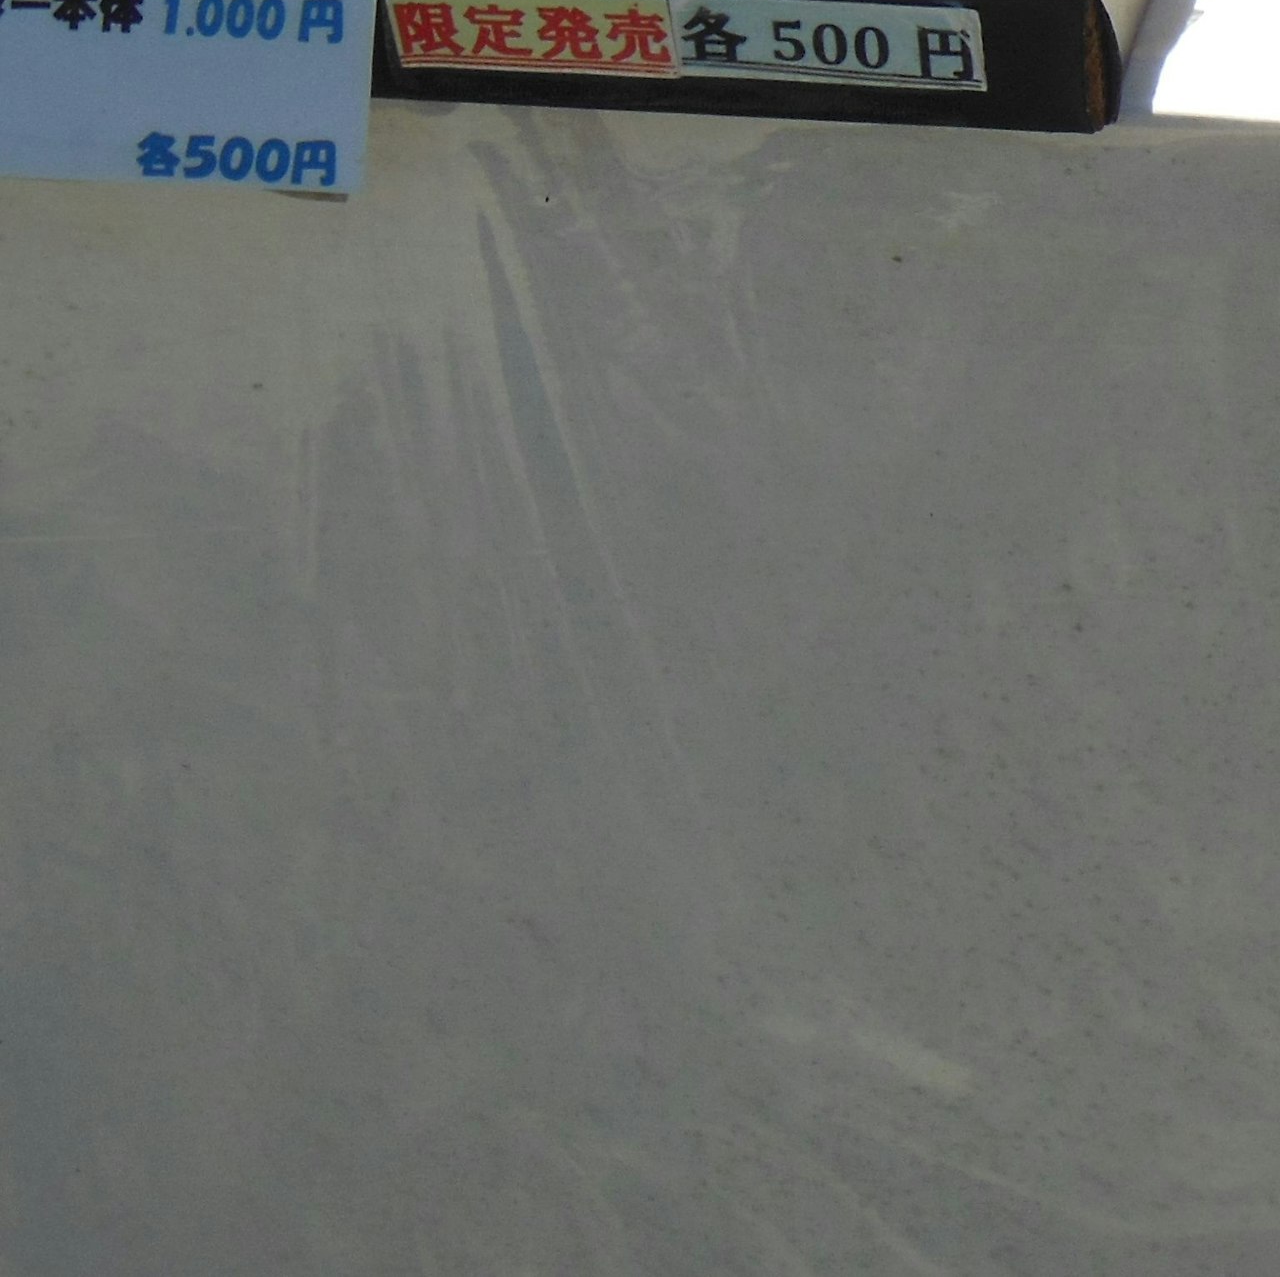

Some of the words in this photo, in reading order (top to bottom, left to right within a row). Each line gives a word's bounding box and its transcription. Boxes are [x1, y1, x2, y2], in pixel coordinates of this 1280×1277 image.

[393, 1, 672, 64] 限定発売
[773, 19, 890, 70] 500
[917, 24, 980, 82] 円
[136, 131, 337, 187] 各500円
